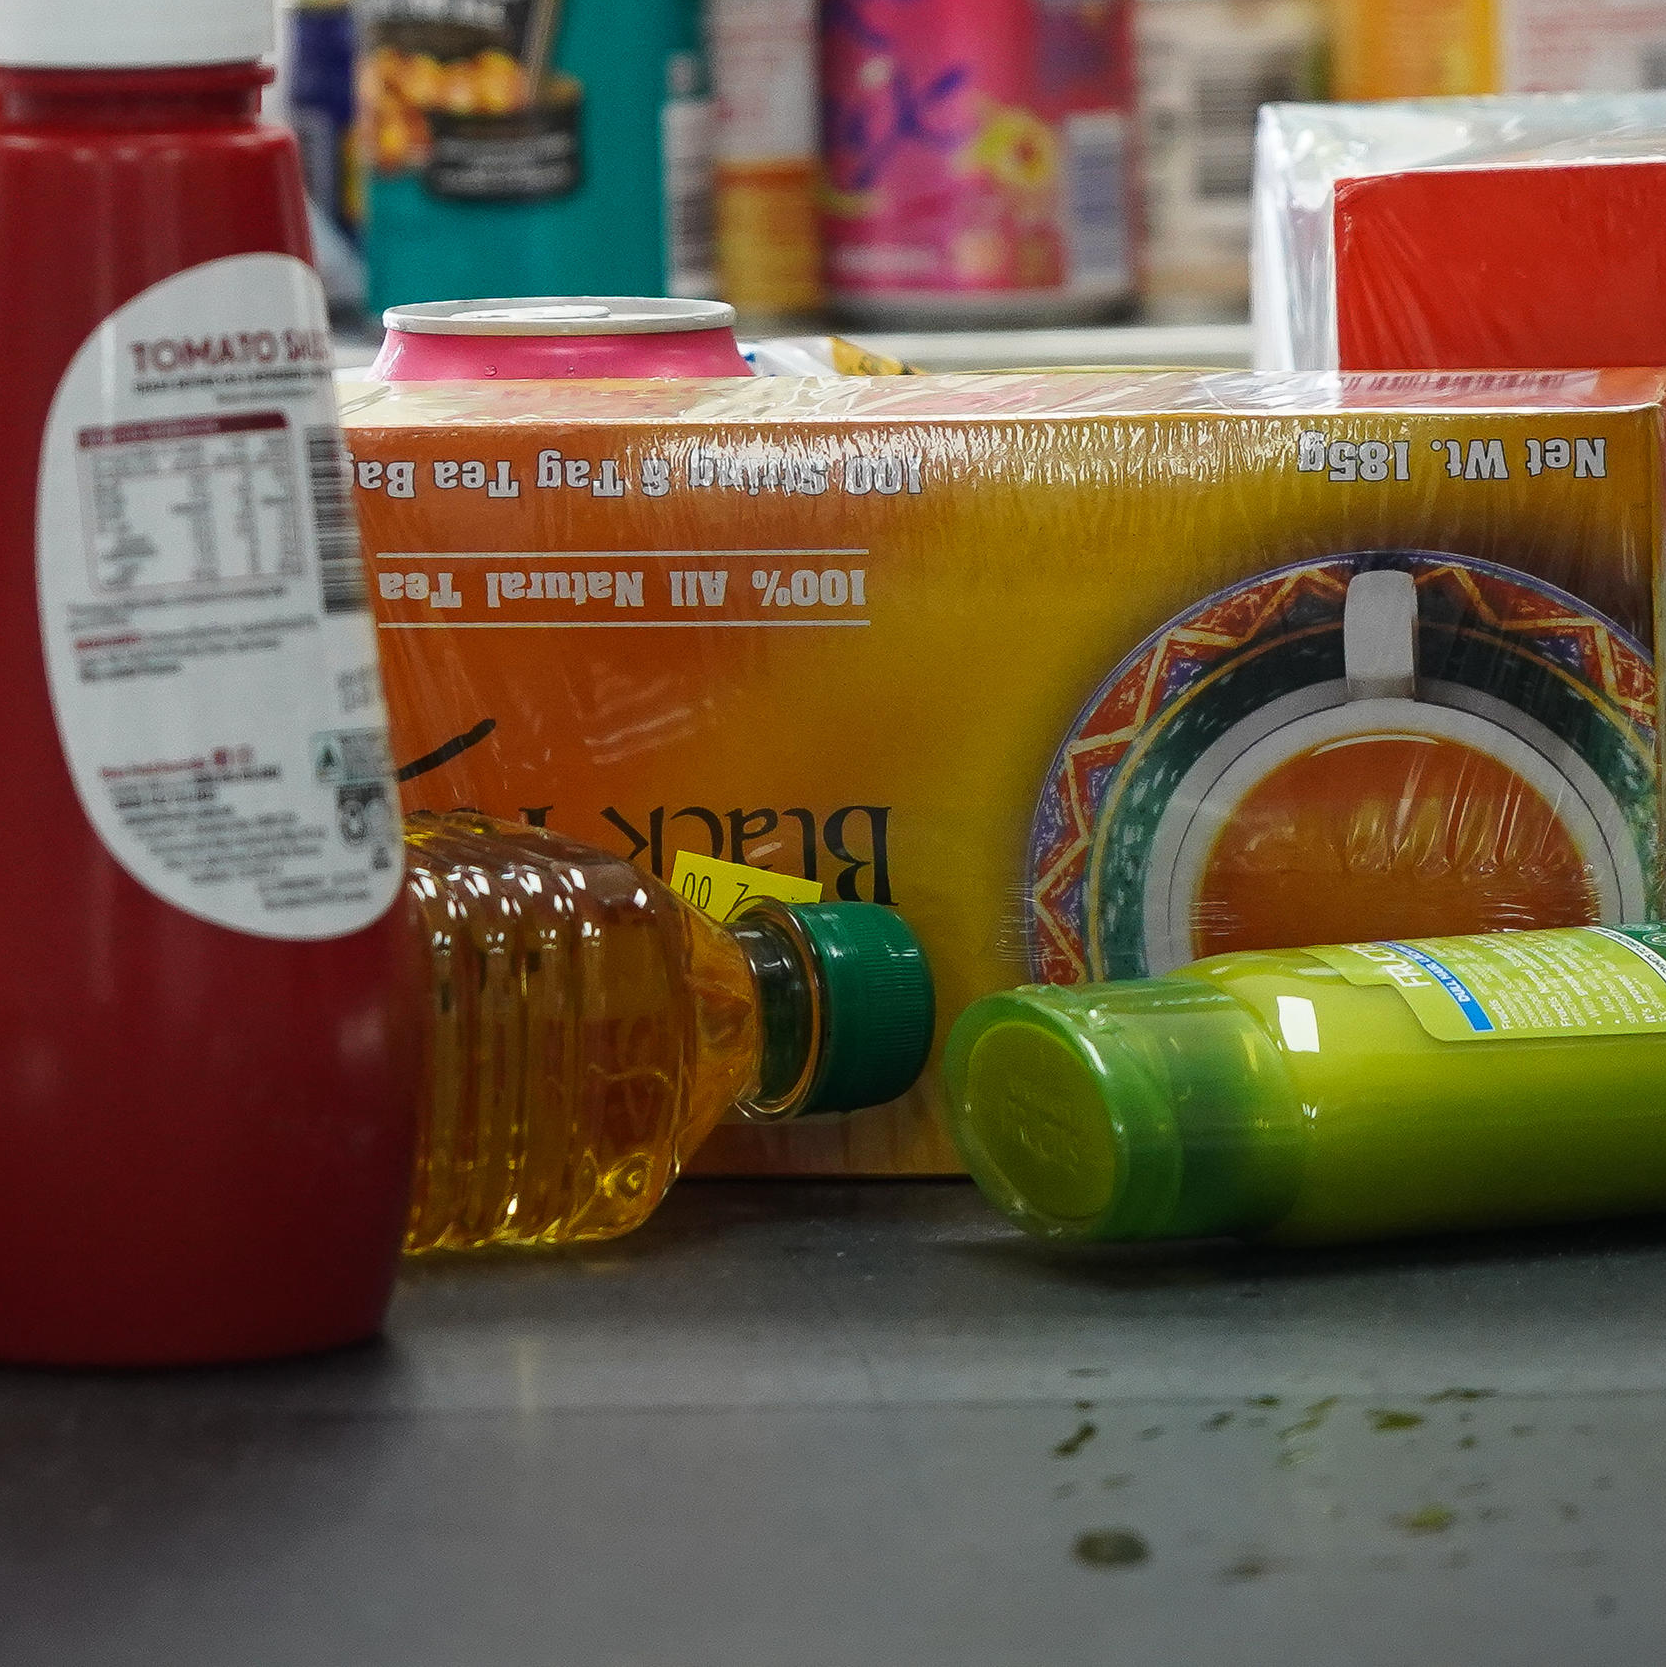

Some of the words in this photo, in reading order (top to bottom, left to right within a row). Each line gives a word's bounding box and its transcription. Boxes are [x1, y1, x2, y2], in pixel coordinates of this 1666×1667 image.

[131, 330, 279, 375] TOMATO
[536, 449, 626, 498] Tag
[689, 446, 827, 498] String
[846, 455, 923, 496] 100
[1297, 429, 1410, 483] 185g
[1430, 438, 1509, 480] Wt.
[1526, 437, 1607, 479] Net
[433, 460, 521, 499] Tea
[641, 458, 673, 498] &
[378, 572, 463, 609] Tea
[486, 571, 645, 608] Natural
[669, 571, 729, 608] All
[751, 570, 867, 607] 100%
[600, 805, 899, 908] Black
[1341, 943, 1432, 988] FRUCT
[1425, 961, 1456, 983] HAIR
[1445, 978, 1471, 1003] DULL
[1597, 995, 1618, 1013] And
[1488, 999, 1514, 1030] Fructis
[1548, 996, 1574, 1027] Fructis
[1641, 1006, 1658, 1024] It's
